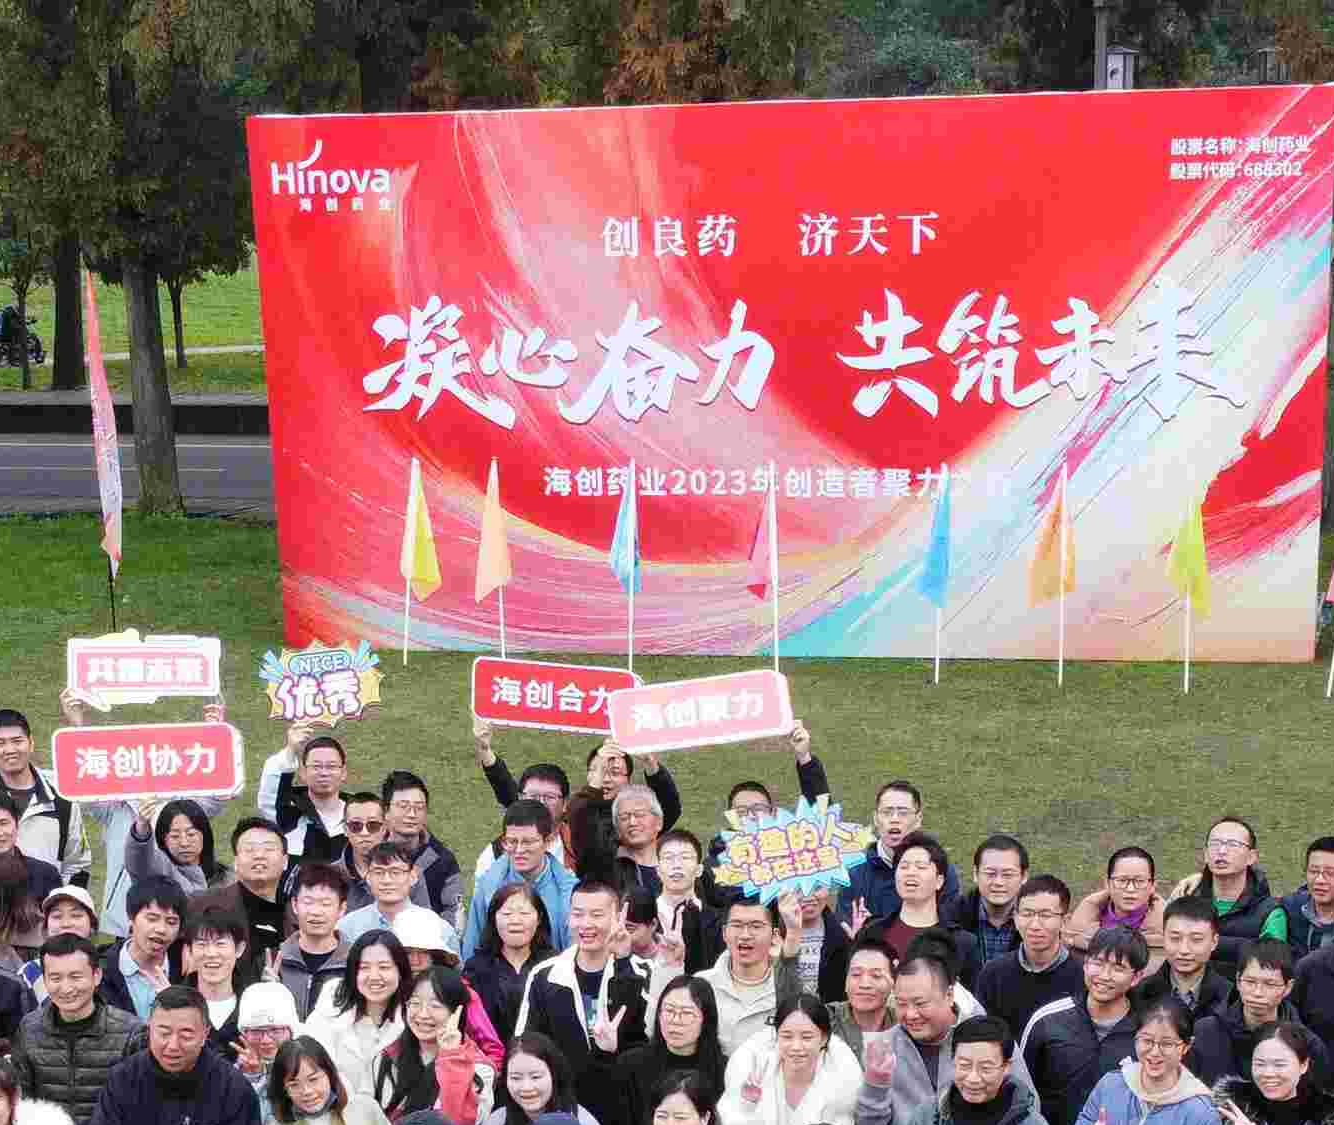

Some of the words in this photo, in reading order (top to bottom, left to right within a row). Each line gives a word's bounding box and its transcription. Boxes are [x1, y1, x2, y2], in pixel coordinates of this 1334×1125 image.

[270, 139, 391, 194] Hinova
[602, 218, 737, 257] 创良药
[799, 212, 941, 256] 济天下
[362, 295, 774, 430] 凝心奋力
[834, 288, 1244, 418] 共筑未来
[276, 669, 364, 717] 优秀
[492, 677, 611, 714] 海创合力
[75, 742, 216, 779] 海创协力
